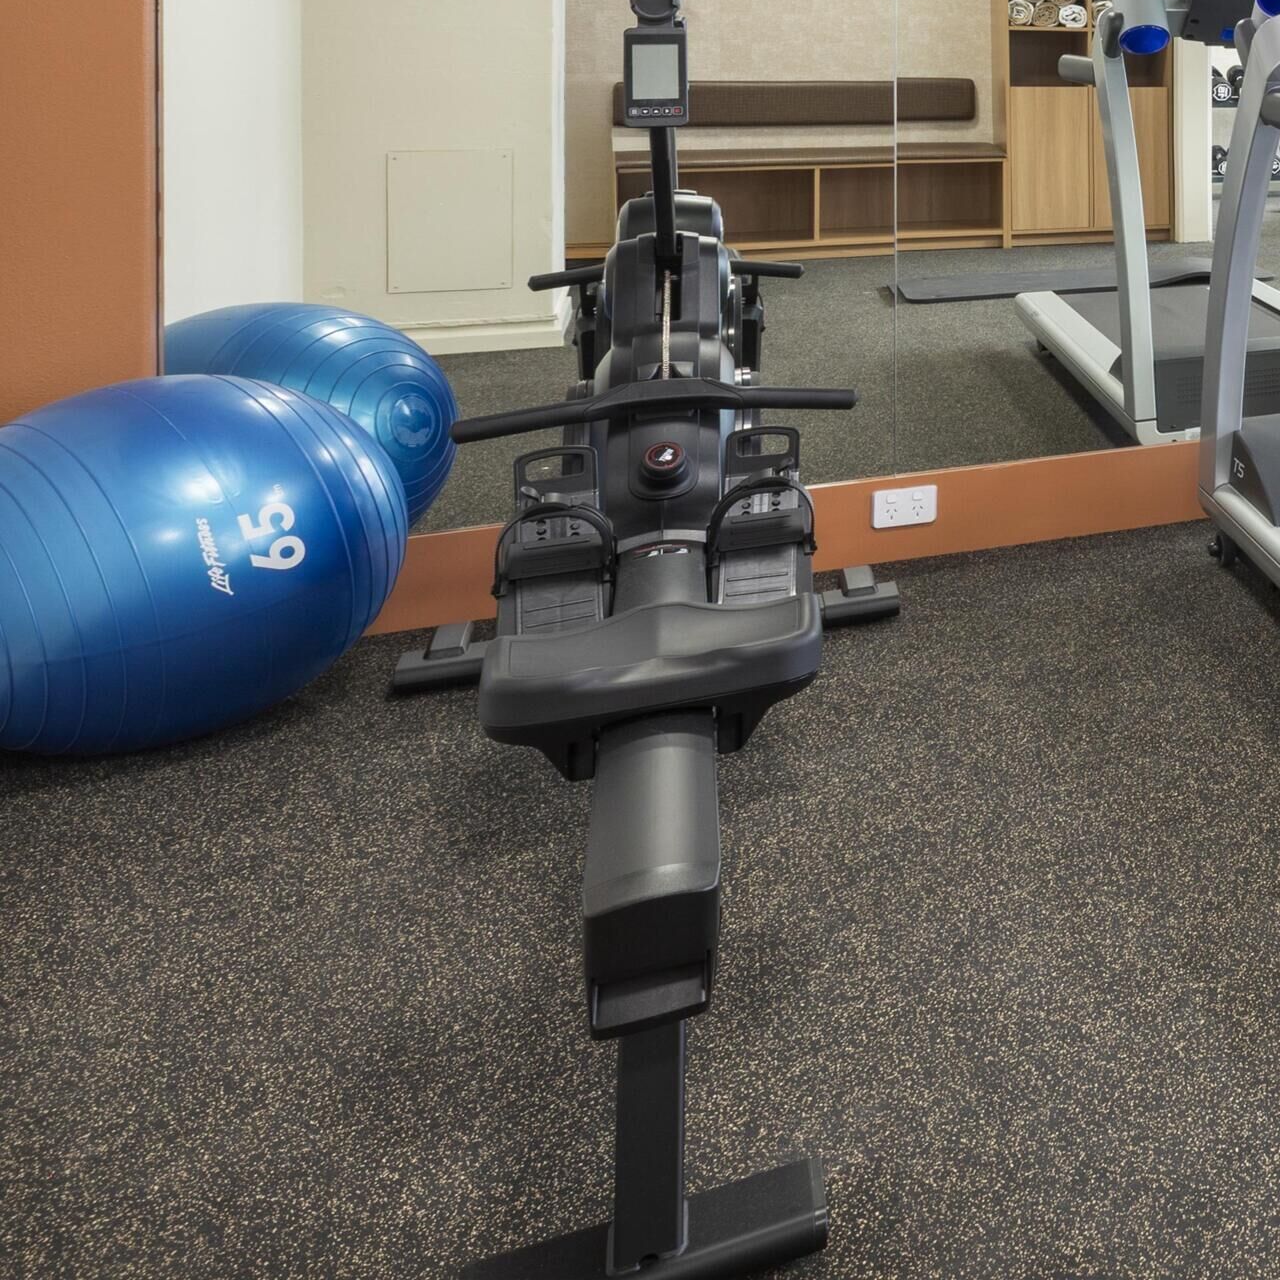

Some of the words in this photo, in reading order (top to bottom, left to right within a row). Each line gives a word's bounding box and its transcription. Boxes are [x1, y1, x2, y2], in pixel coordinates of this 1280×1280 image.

[1233, 457, 1246, 479] T5
[195, 518, 227, 567] Fitness
[237, 502, 306, 570] 65
[206, 566, 235, 596] Life
